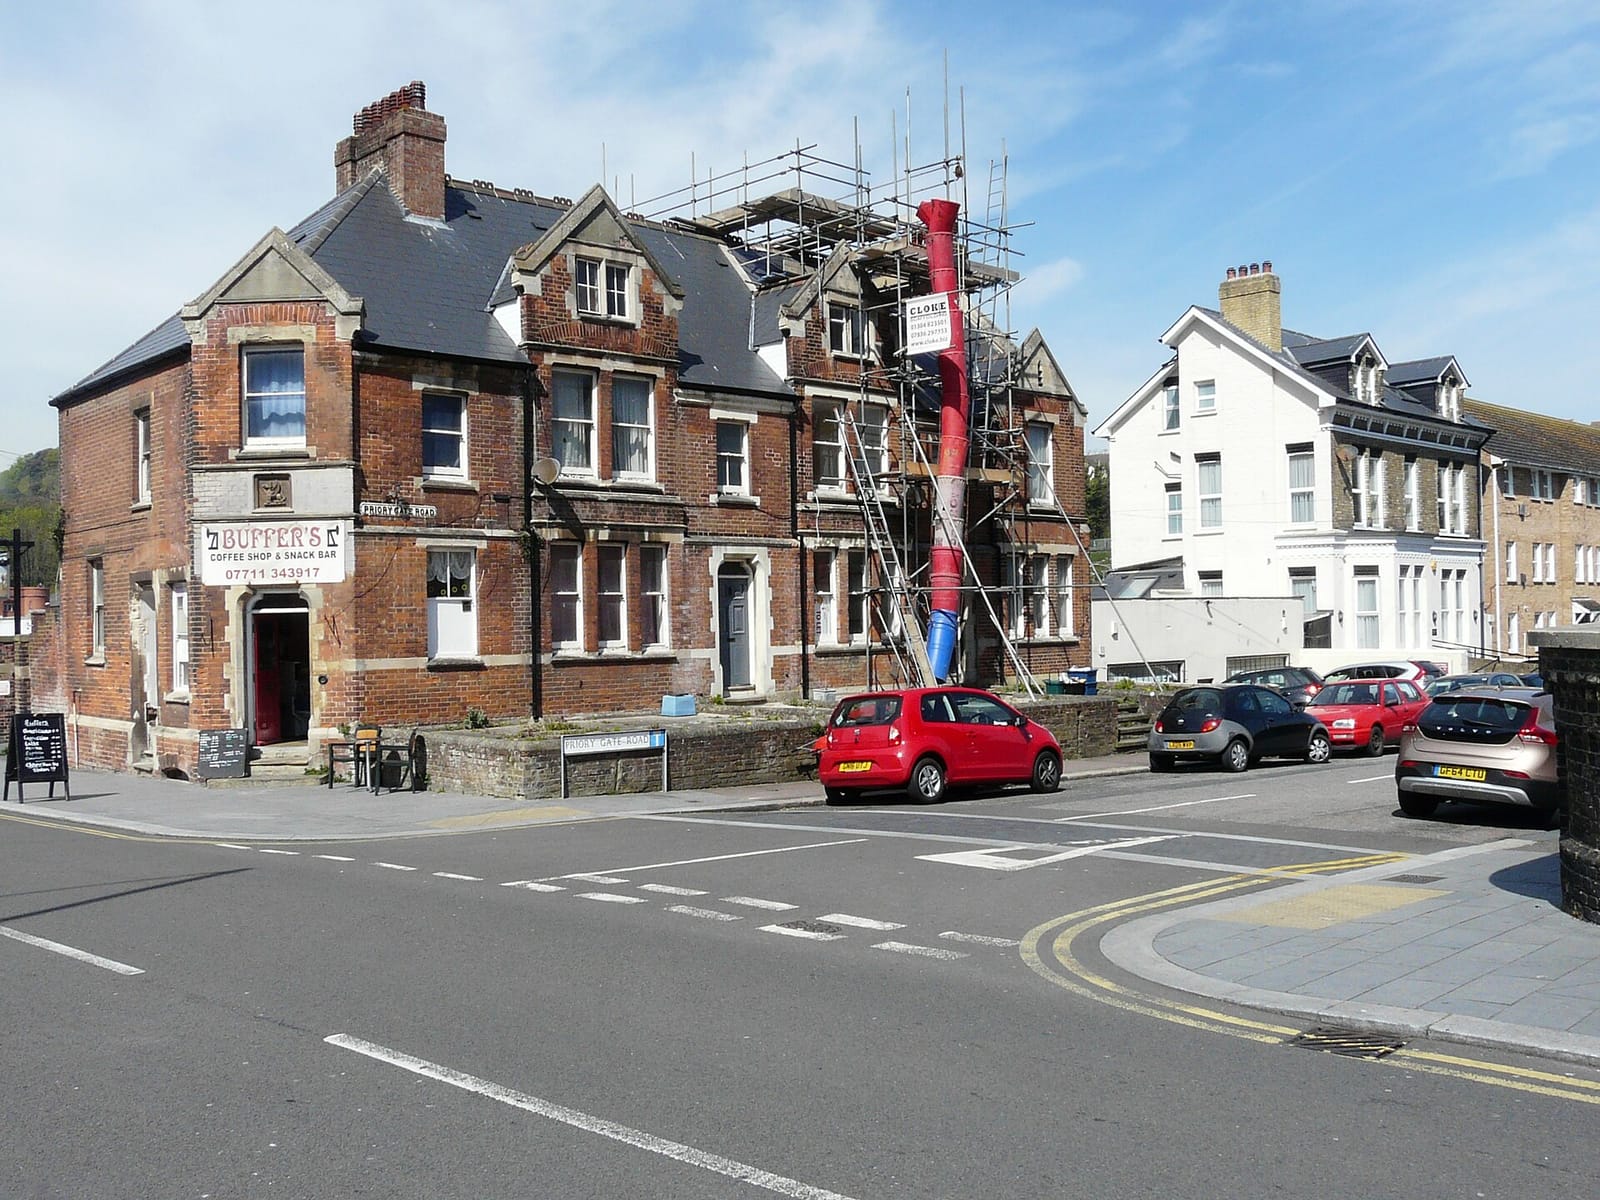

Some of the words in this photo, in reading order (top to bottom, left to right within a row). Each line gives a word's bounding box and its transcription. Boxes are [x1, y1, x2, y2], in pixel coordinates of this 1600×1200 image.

[910, 302, 947, 315] CLOKE
[364, 505, 393, 515] PRIORY
[394, 506, 414, 516] GATE
[415, 507, 435, 516] ROAD
[222, 526, 321, 550] BUFFER'S
[210, 553, 244, 562] COFFEE
[247, 552, 272, 561] SHOP
[275, 552, 281, 560] &
[284, 551, 315, 560] SNACK
[318, 550, 337, 559] BAR
[225, 569, 265, 580] 07711
[271, 567, 320, 579] 343917
[565, 739, 595, 750] PRIORY
[600, 737, 622, 747] GATE
[626, 735, 649, 745] ROAD
[1440, 765, 1462, 776] GF64
